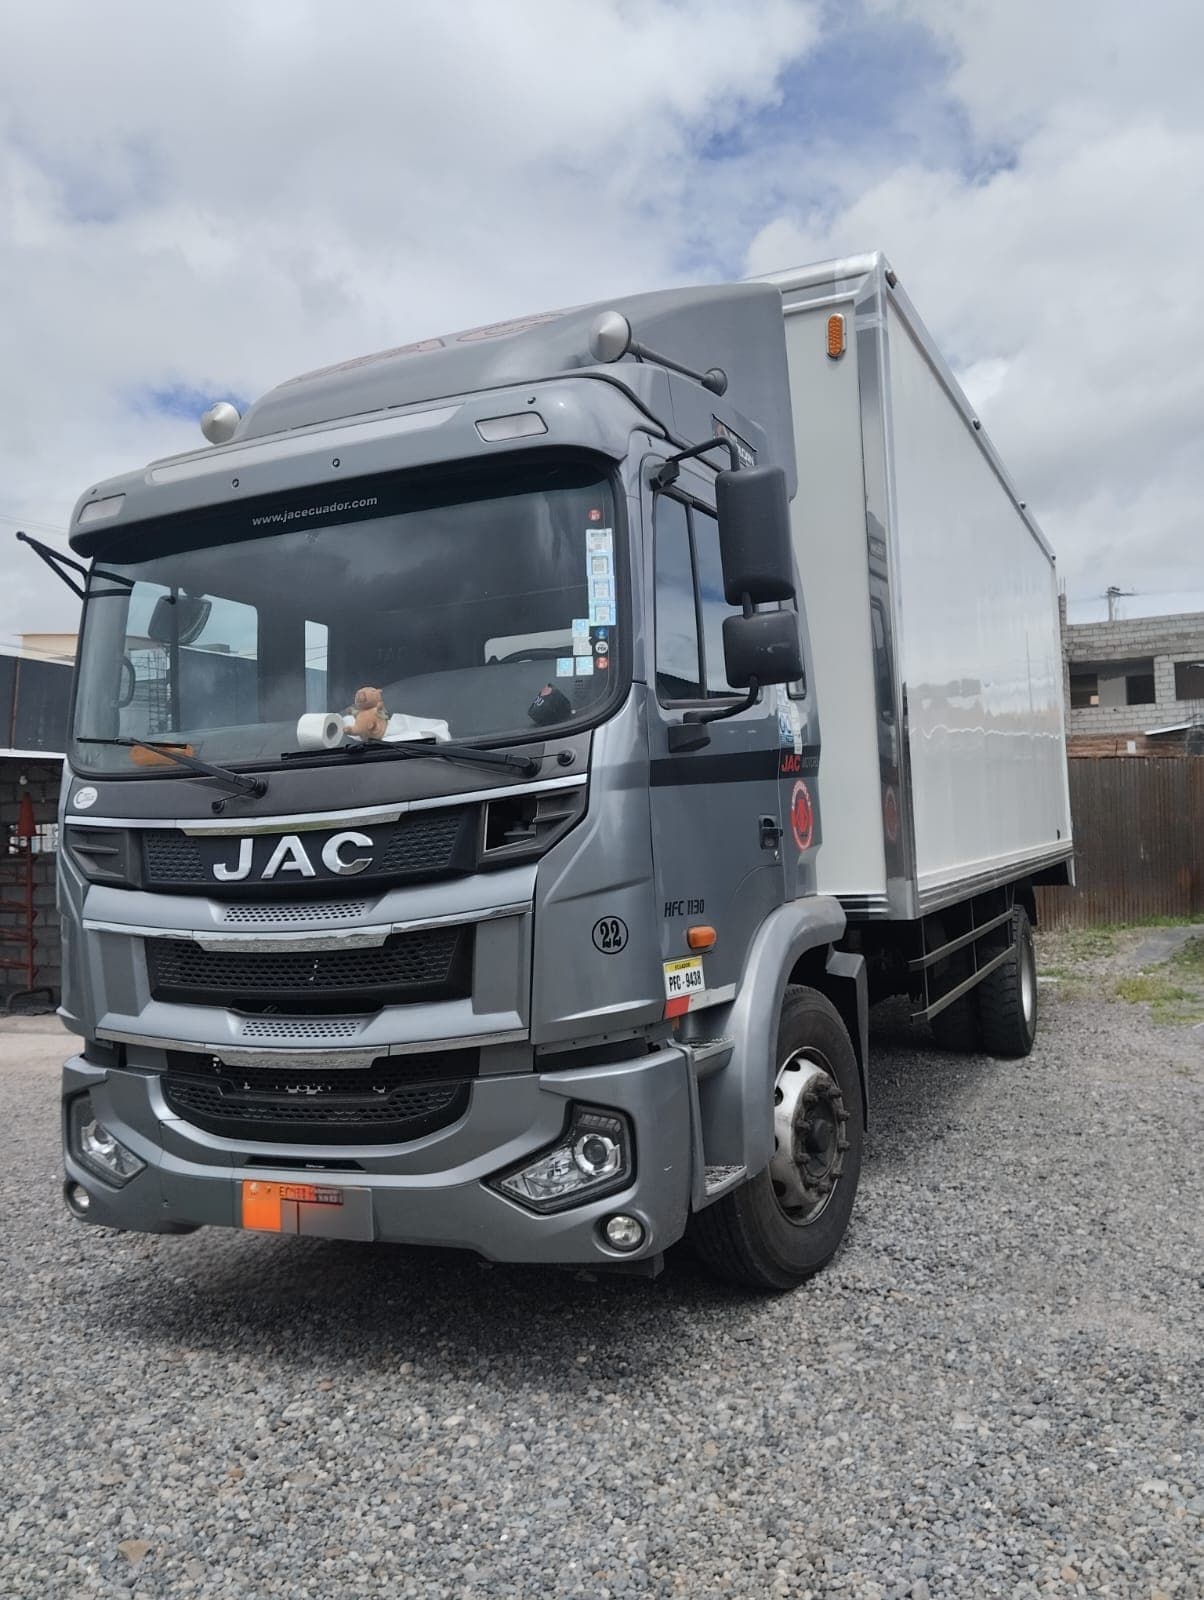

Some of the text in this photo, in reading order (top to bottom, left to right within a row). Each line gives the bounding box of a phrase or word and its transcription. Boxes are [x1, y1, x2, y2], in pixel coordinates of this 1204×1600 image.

[252, 497, 378, 526] www.jacecuador.com
[781, 754, 801, 772] JAC
[213, 831, 374, 881] JAC
[664, 899, 705, 917] HFC 1130
[600, 920, 621, 948] 22
